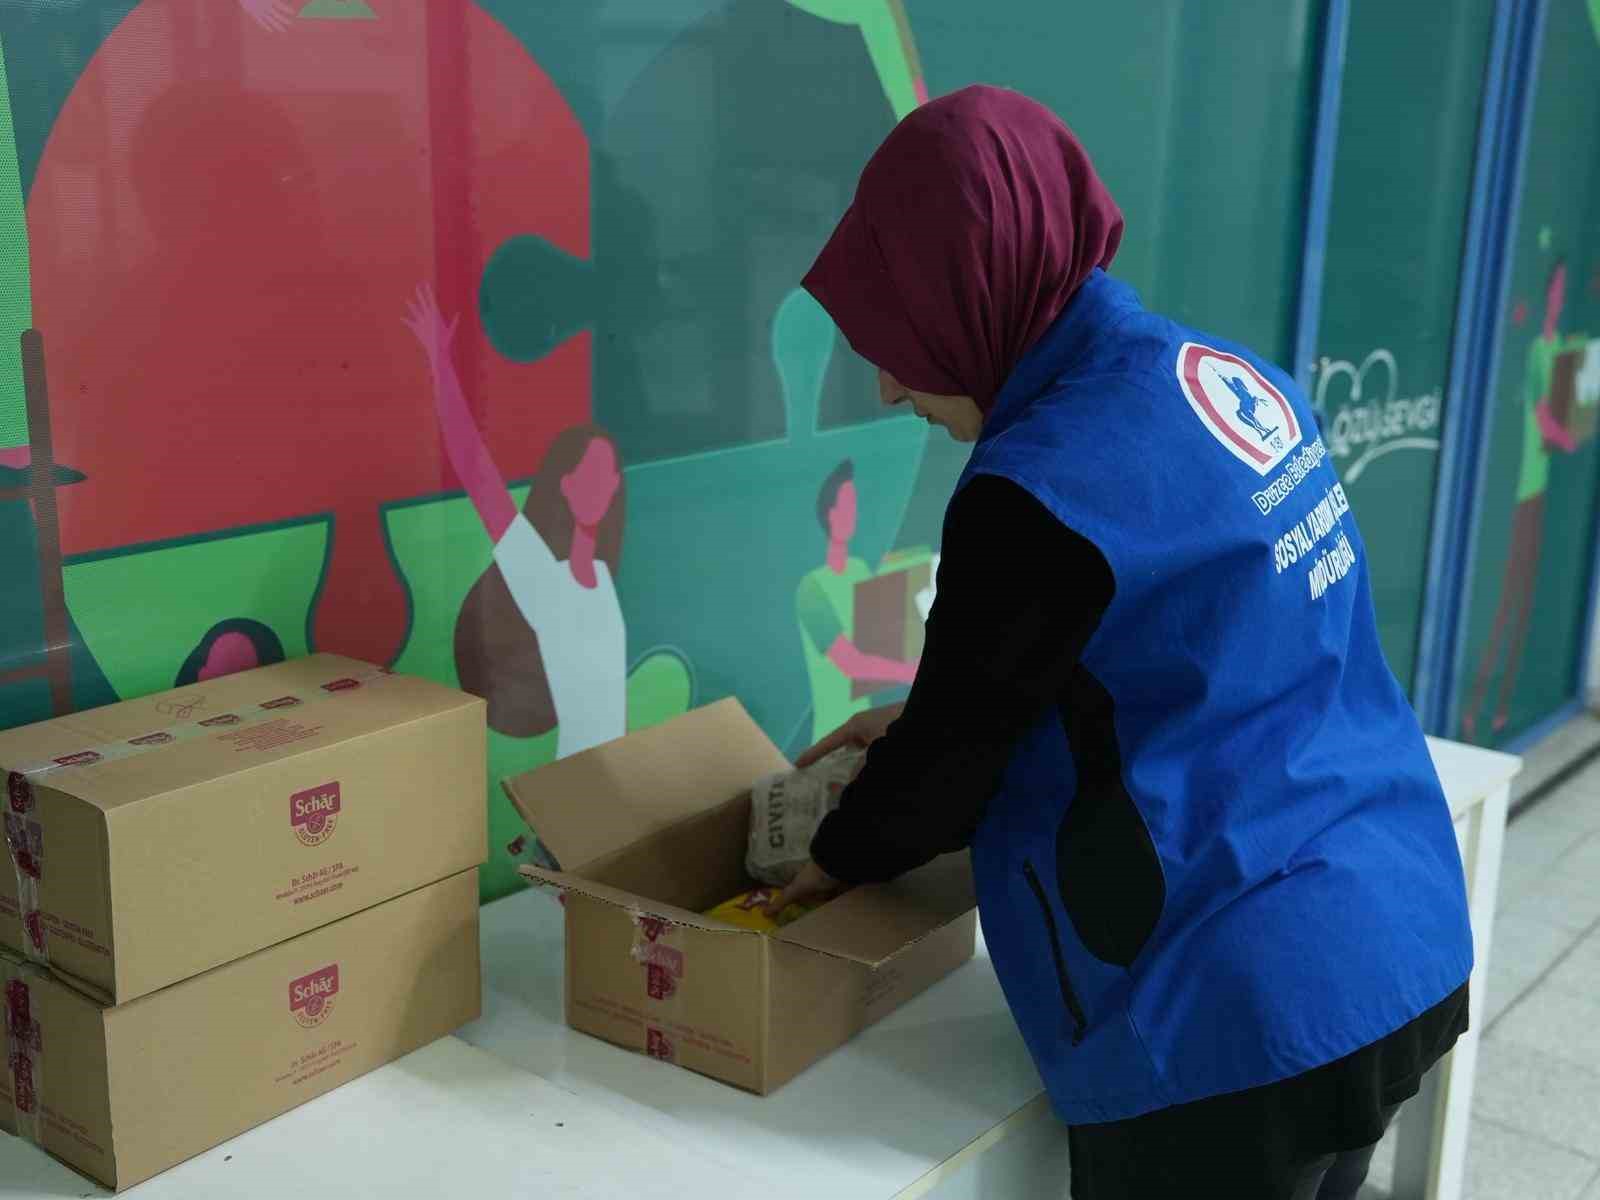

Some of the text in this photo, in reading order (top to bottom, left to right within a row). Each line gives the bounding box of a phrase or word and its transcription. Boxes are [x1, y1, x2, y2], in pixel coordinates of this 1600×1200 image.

[1274, 521, 1314, 574] SOSYAL
[295, 793, 336, 817] Schär
[294, 975, 334, 1002] Schär
